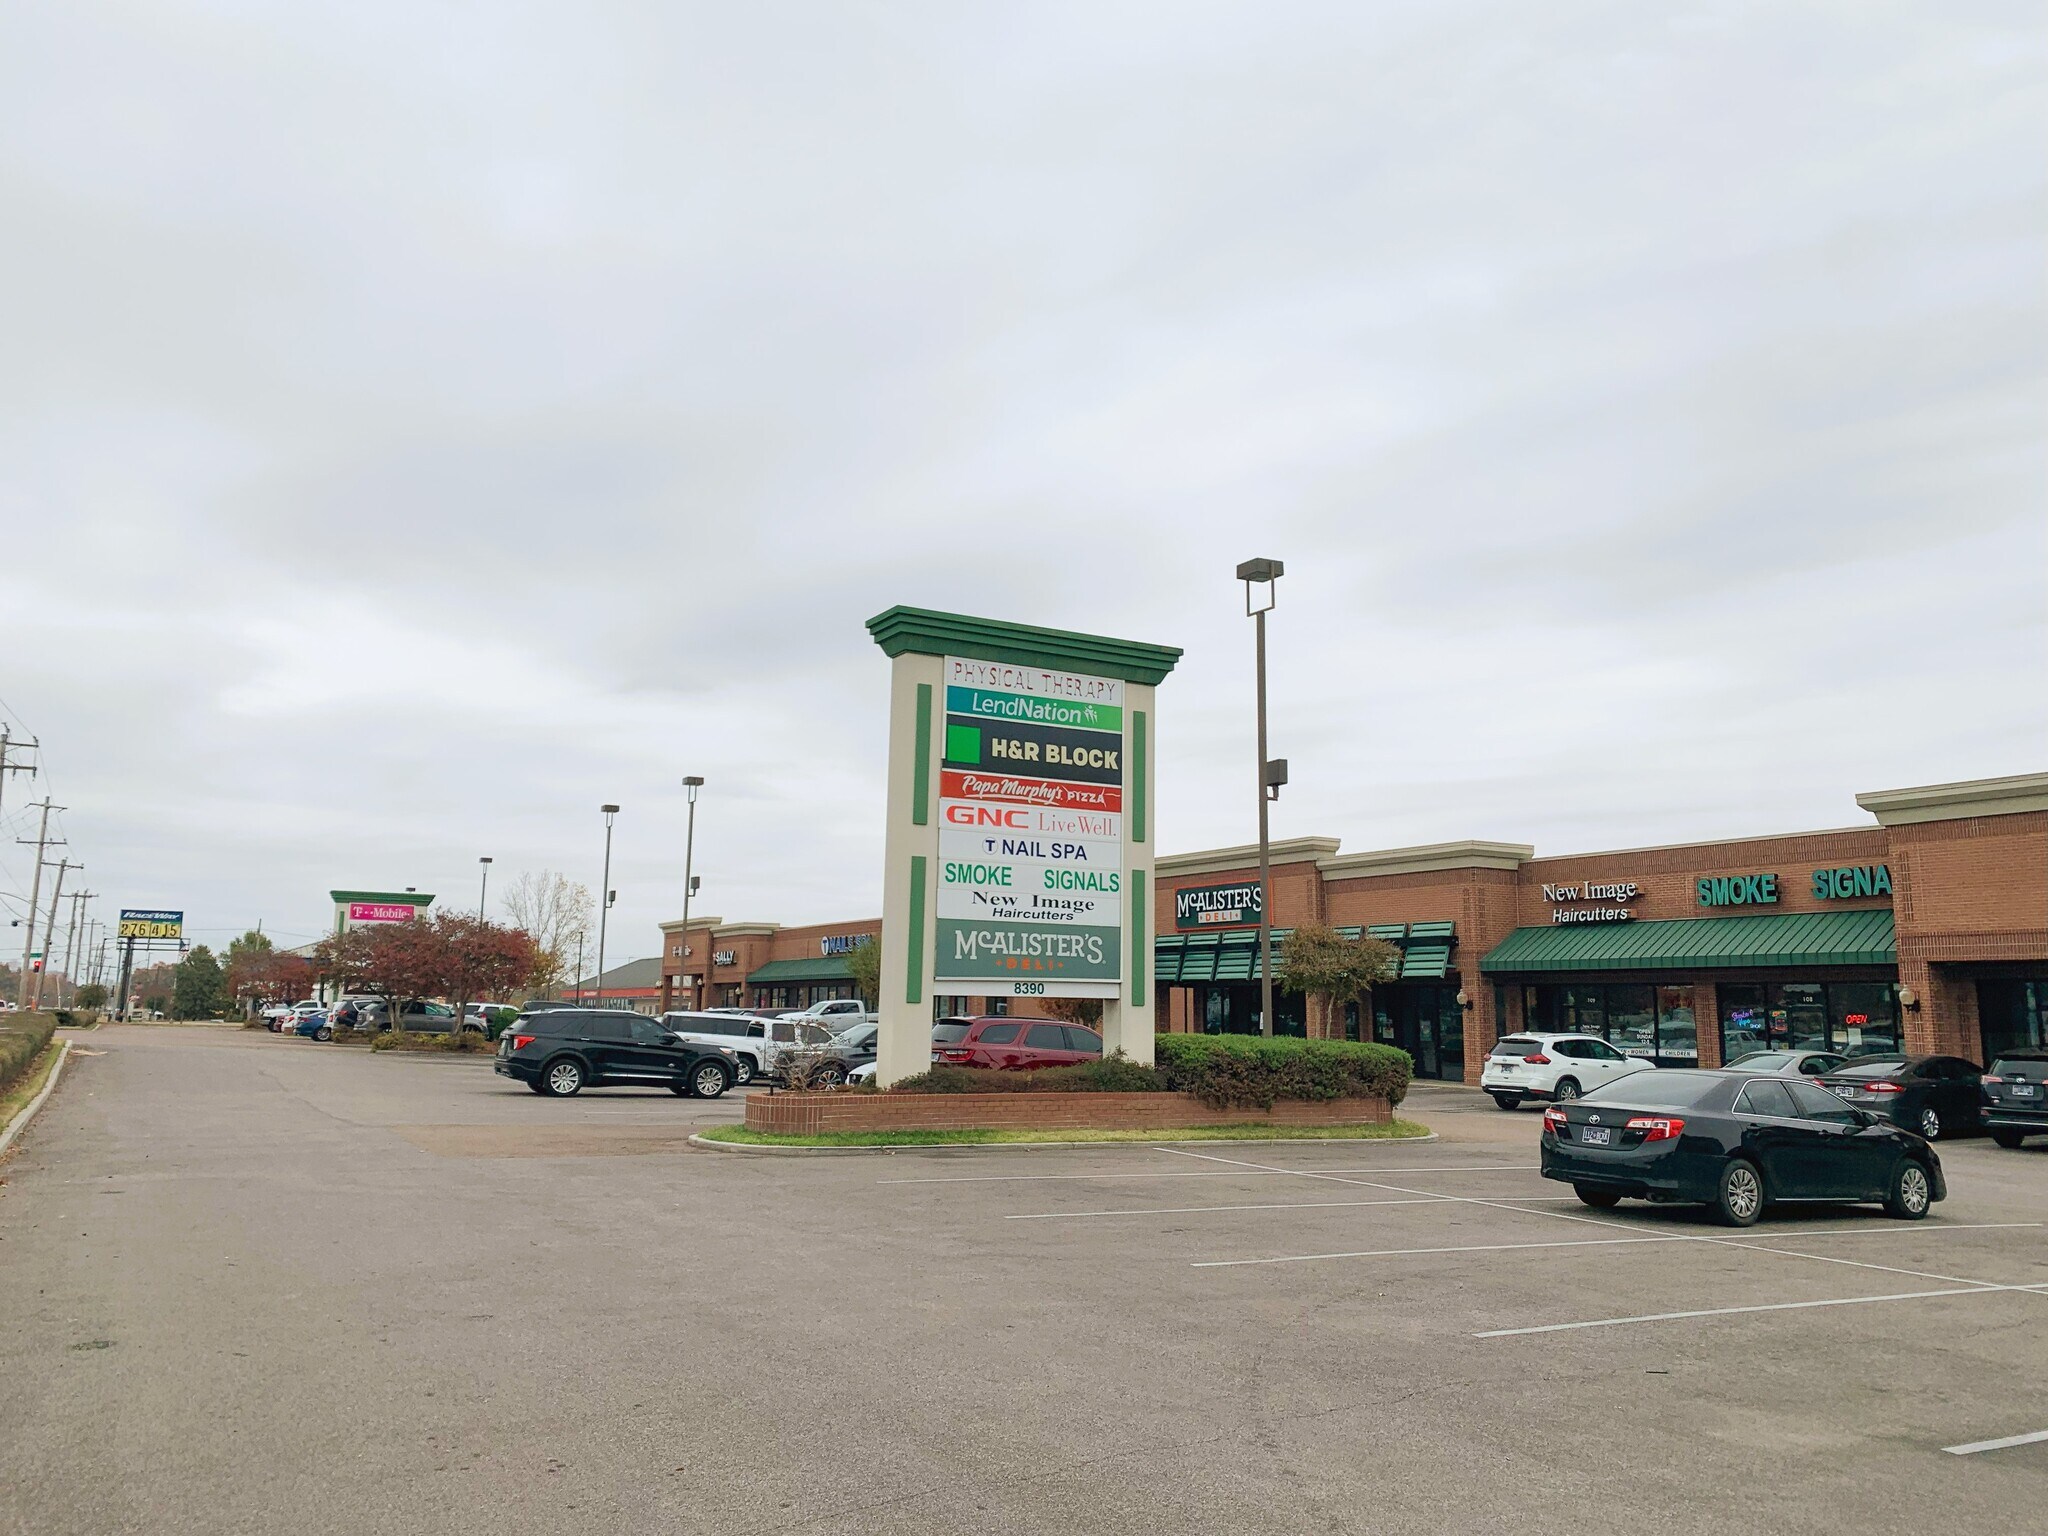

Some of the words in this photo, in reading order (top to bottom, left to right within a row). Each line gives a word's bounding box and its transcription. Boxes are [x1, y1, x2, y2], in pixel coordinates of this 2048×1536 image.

[954, 662, 1034, 690] PHYSICAL
[1041, 673, 1116, 701] THERAPY
[972, 692, 1081, 723] LendNation
[991, 737, 1040, 762] H&R
[1045, 744, 1119, 770] BLOCK
[961, 775, 1000, 800] Papa
[1065, 791, 1105, 804] PIZZA
[946, 805, 1029, 829] GNC
[1002, 839, 1046, 858] NAIL
[1051, 843, 1088, 861] SPA
[945, 862, 1013, 887] SMOKE
[1043, 869, 1120, 893] SIGNALS
[1697, 874, 1777, 907] SMOKE
[1812, 864, 1894, 900] SIGNA
[971, 891, 1018, 906] New
[1031, 895, 1095, 913] Image
[1177, 886, 1261, 917] McALISTER'S
[1541, 883, 1579, 902] New
[1583, 881, 1636, 903] Image
[992, 907, 1074, 921] Haircutters
[1205, 912, 1232, 921] DELI
[1552, 907, 1628, 923] Haircutters
[716, 950, 734, 962] SALLY
[1006, 957, 1053, 970] DELI
[1014, 982, 1045, 995] 8390
[1846, 1014, 1867, 1024] OPEN
